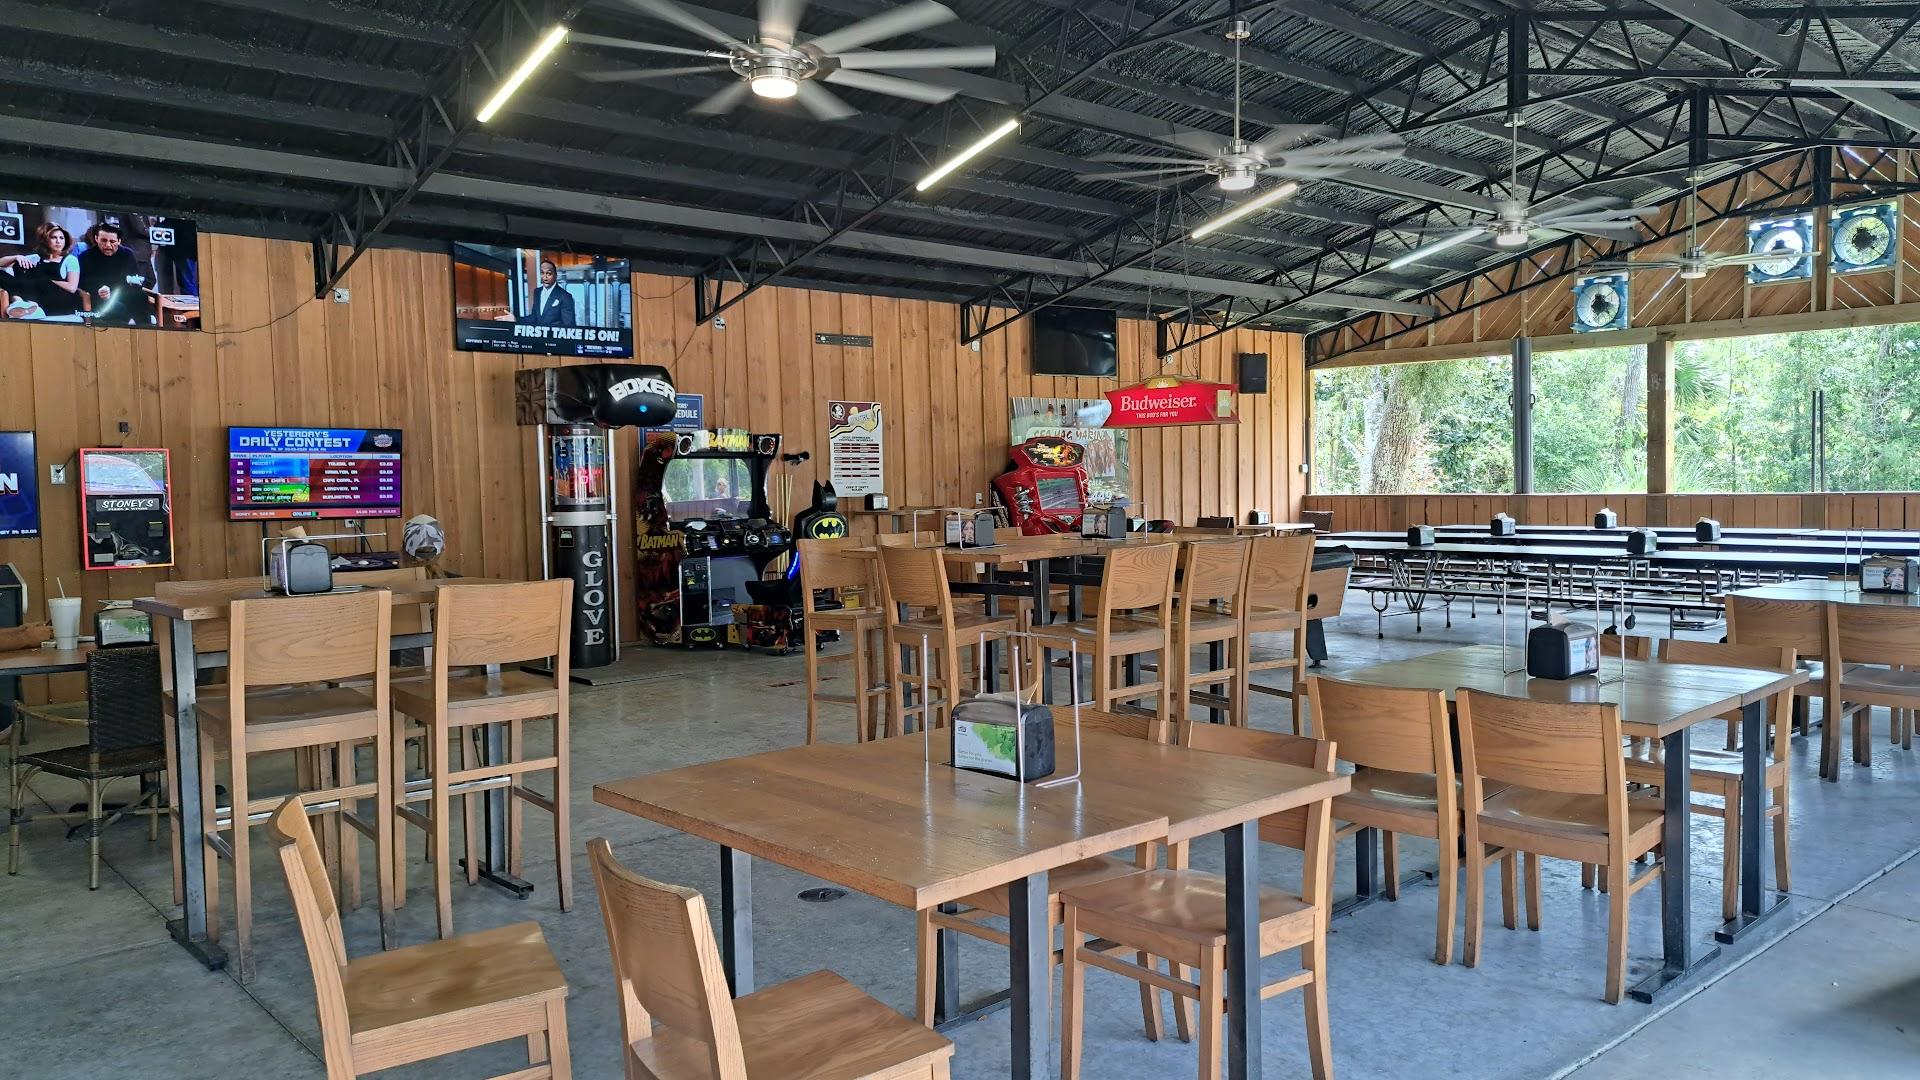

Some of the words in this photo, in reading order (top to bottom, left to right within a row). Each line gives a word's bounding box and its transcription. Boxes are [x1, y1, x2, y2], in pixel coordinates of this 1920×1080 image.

[153, 231, 171, 242] CC
[514, 324, 550, 338] FIRST
[552, 327, 582, 340] TAKE
[585, 328, 596, 340] IS
[598, 330, 620, 342] ON!
[608, 377, 676, 403] BOXER
[675, 409, 698, 419] HEDULE
[1136, 411, 1146, 419] THIS
[264, 430, 329, 438] YESTERDAY'S
[240, 437, 281, 447] DAILY
[285, 437, 352, 448] CONTEST
[707, 432, 750, 448] BATMAN
[102, 499, 154, 509] STONEY'S
[640, 534, 678, 550] BATMAN
[582, 551, 605, 646] GLOVE
